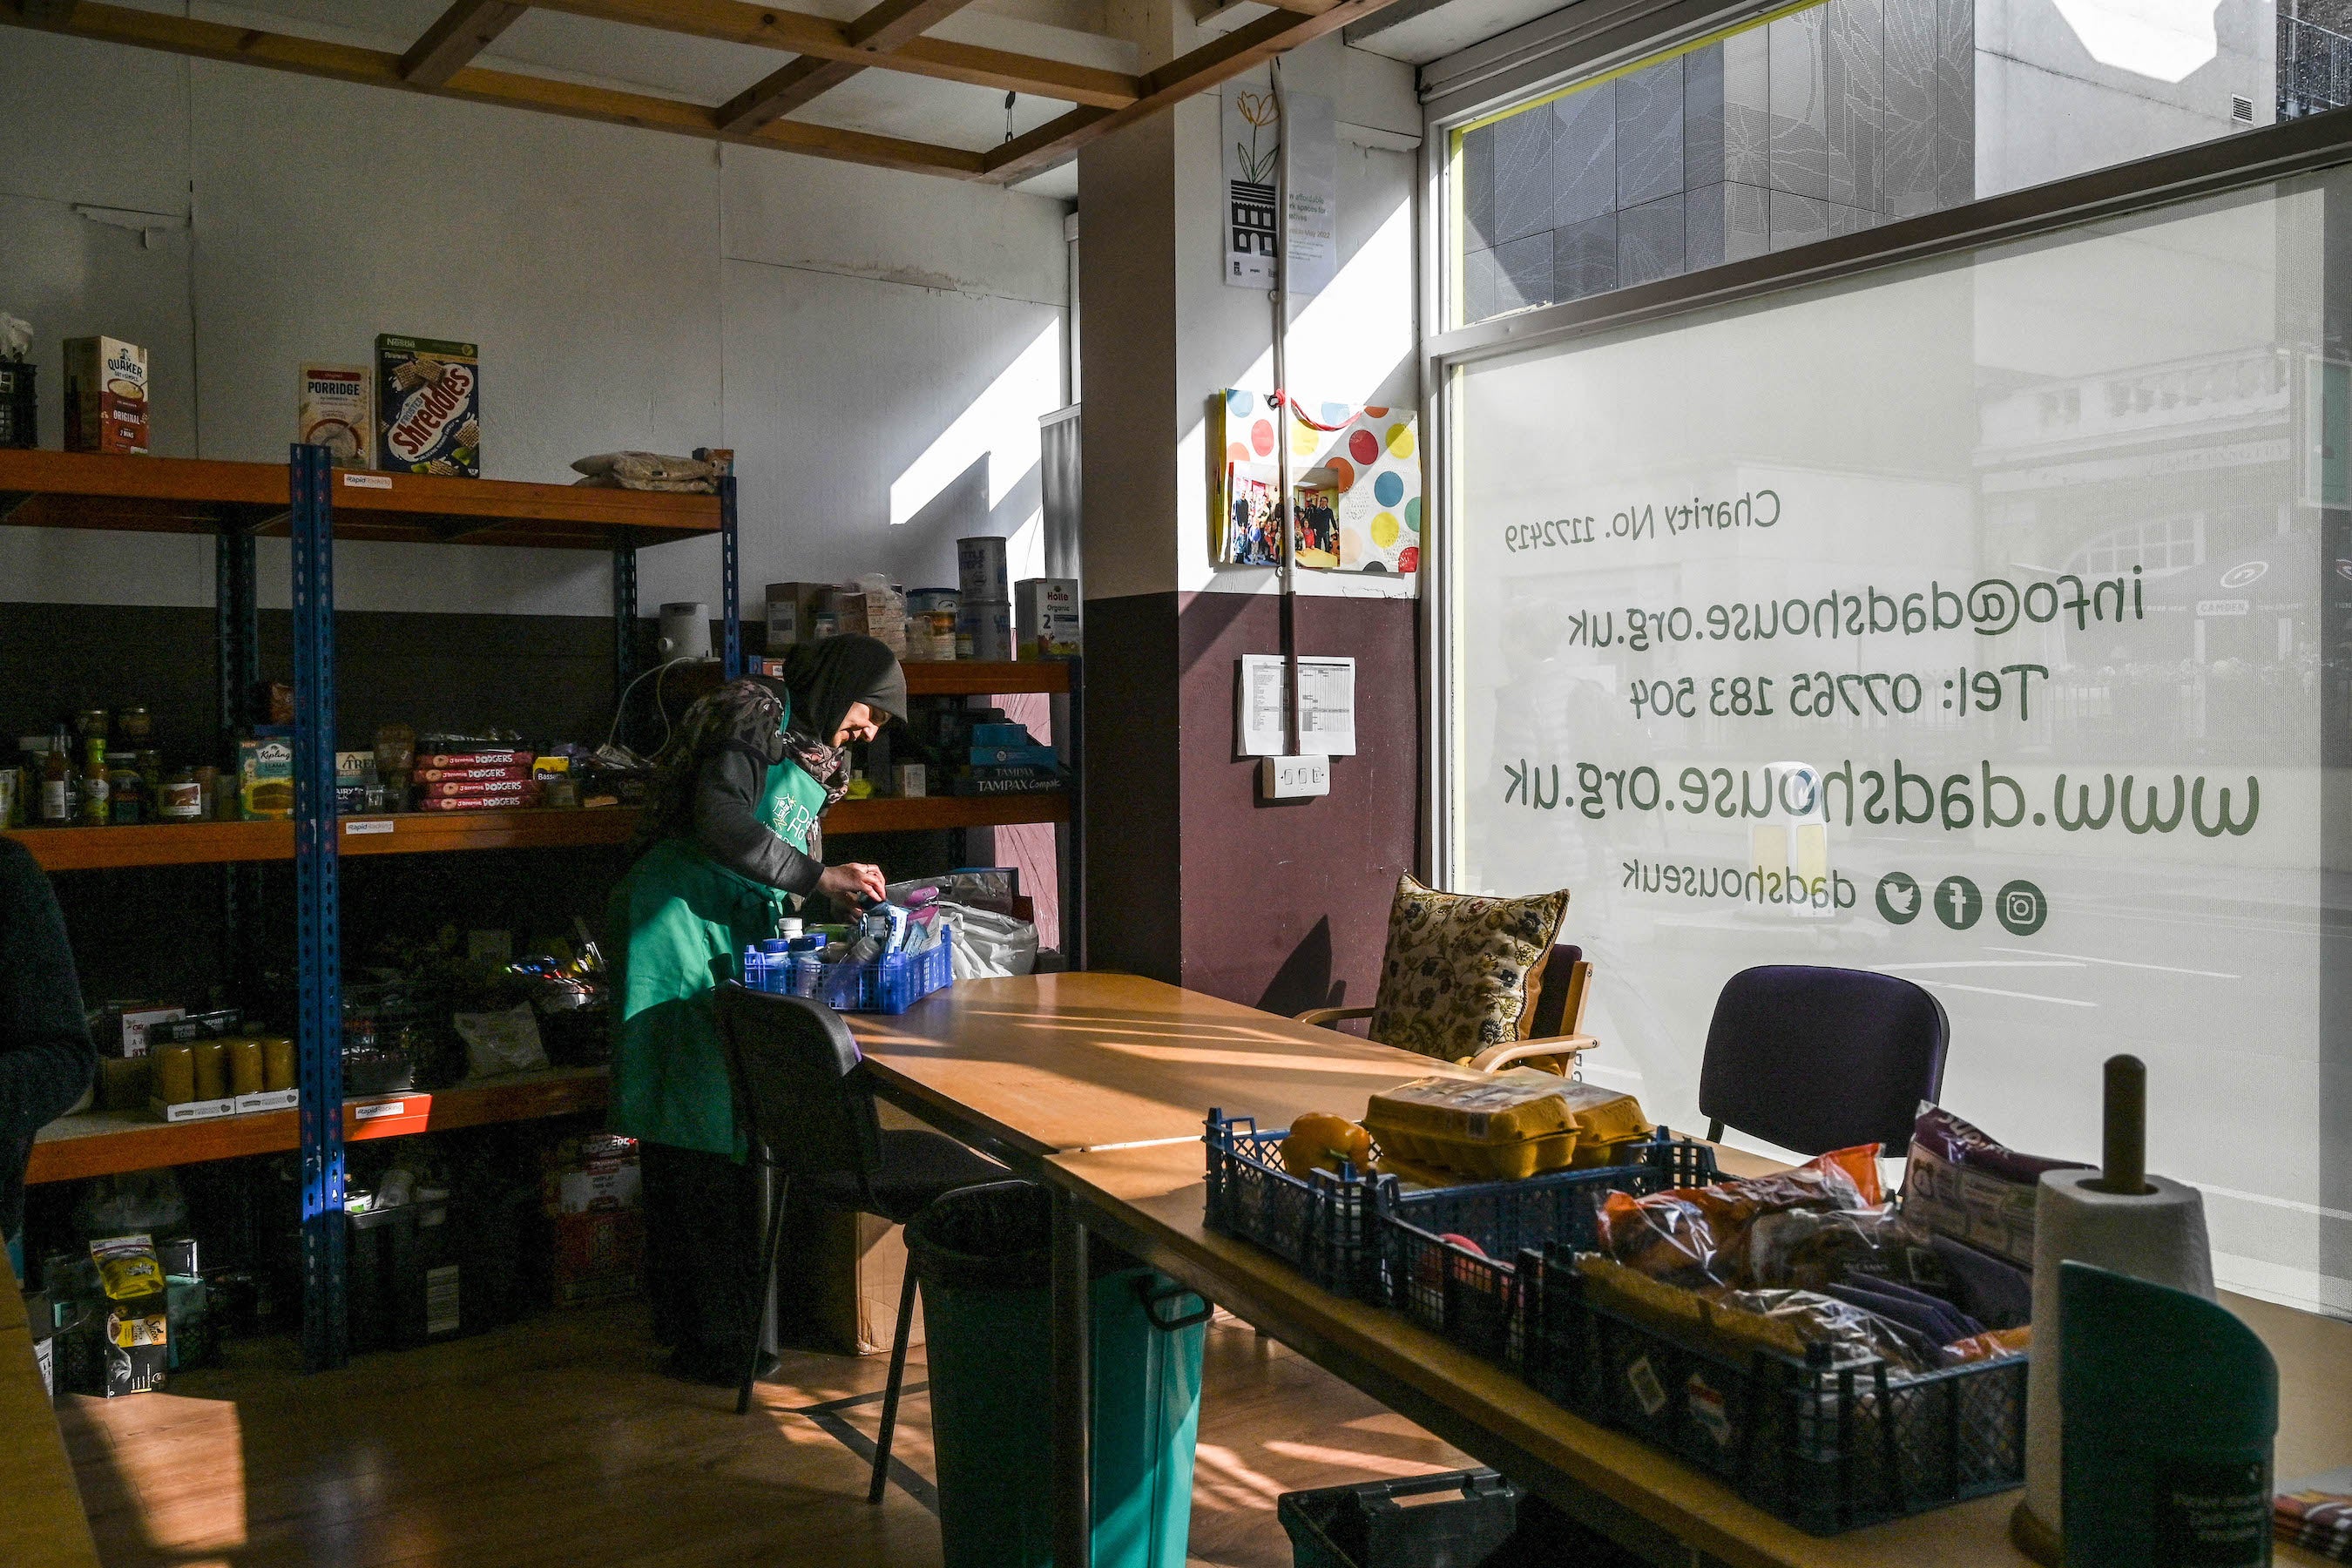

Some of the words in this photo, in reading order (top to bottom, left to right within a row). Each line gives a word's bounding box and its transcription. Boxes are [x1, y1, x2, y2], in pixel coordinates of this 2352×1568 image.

[107, 359, 143, 378] QUAKER
[308, 382, 361, 396] PORRIDGE
[113, 409, 141, 425] ORIGINAL
[392, 368, 470, 456] Shreddies
[1047, 592, 1069, 601] Holle
[1043, 614, 1051, 629] 2
[260, 750, 291, 760] Kipling
[475, 754, 513, 764] DODGERS
[468, 768, 506, 778] DODGERS
[996, 767, 1035, 778] TAMPAX
[484, 781, 522, 792] DODGERS
[977, 779, 1028, 792] TAMPAX
[483, 797, 520, 807] DODGERS
[146, 1319, 162, 1342] Sheba
